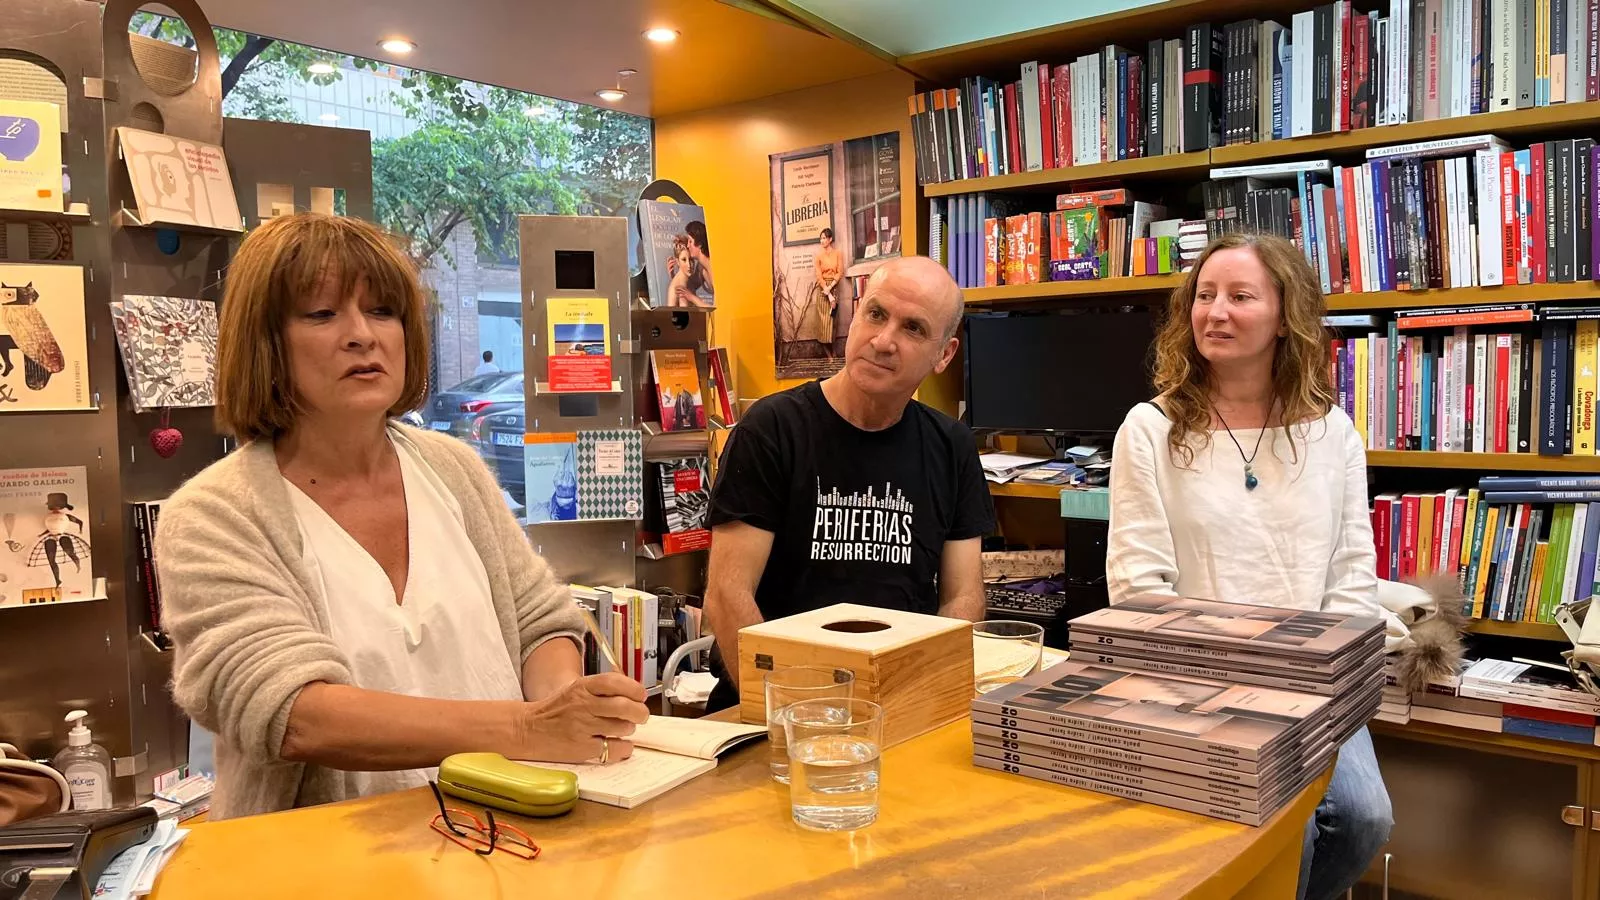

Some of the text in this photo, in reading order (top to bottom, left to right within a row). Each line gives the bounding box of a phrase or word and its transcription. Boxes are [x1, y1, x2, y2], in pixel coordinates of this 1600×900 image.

[1274, 105, 1282, 113] EL
[1486, 155, 1495, 202] Pablo Picasso
[787, 197, 828, 225] LIBRERÍA
[1504, 195, 1513, 224] FRONTERAS
[1582, 391, 1593, 431] Covadonga
[813, 507, 912, 545] PERIFERIAS
[811, 541, 912, 564] RESURRECTION
[1098, 636, 1113, 644] NO
[1182, 648, 1210, 656] carbonell
[1211, 650, 1227, 658] paula
[1099, 655, 1113, 663] NO
[1183, 667, 1210, 676] carbonell
[1021, 674, 1102, 704] NO
[1001, 706, 1017, 716] NO
[1001, 717, 1017, 726] NO
[1049, 715, 1141, 736] paula carbonell isidro ferrer
[1002, 730, 1018, 739] NO
[1067, 730, 1084, 738] isidro
[1003, 739, 1019, 749] NO
[1092, 734, 1121, 746] carbonell
[1122, 739, 1140, 748] paula
[1050, 739, 1141, 761] paula carbonell isidro ferrer
[1004, 752, 1020, 761] NO
[1069, 754, 1086, 762] isidro
[1003, 763, 1019, 773] NO
[1052, 762, 1068, 771] ferrer
[1093, 758, 1122, 770] carbonell
[1123, 764, 1141, 773] paula
[1095, 771, 1123, 783] carbonell
[1125, 776, 1143, 785] paula
[1051, 774, 1142, 797] paula carbonell isidro ferrer
